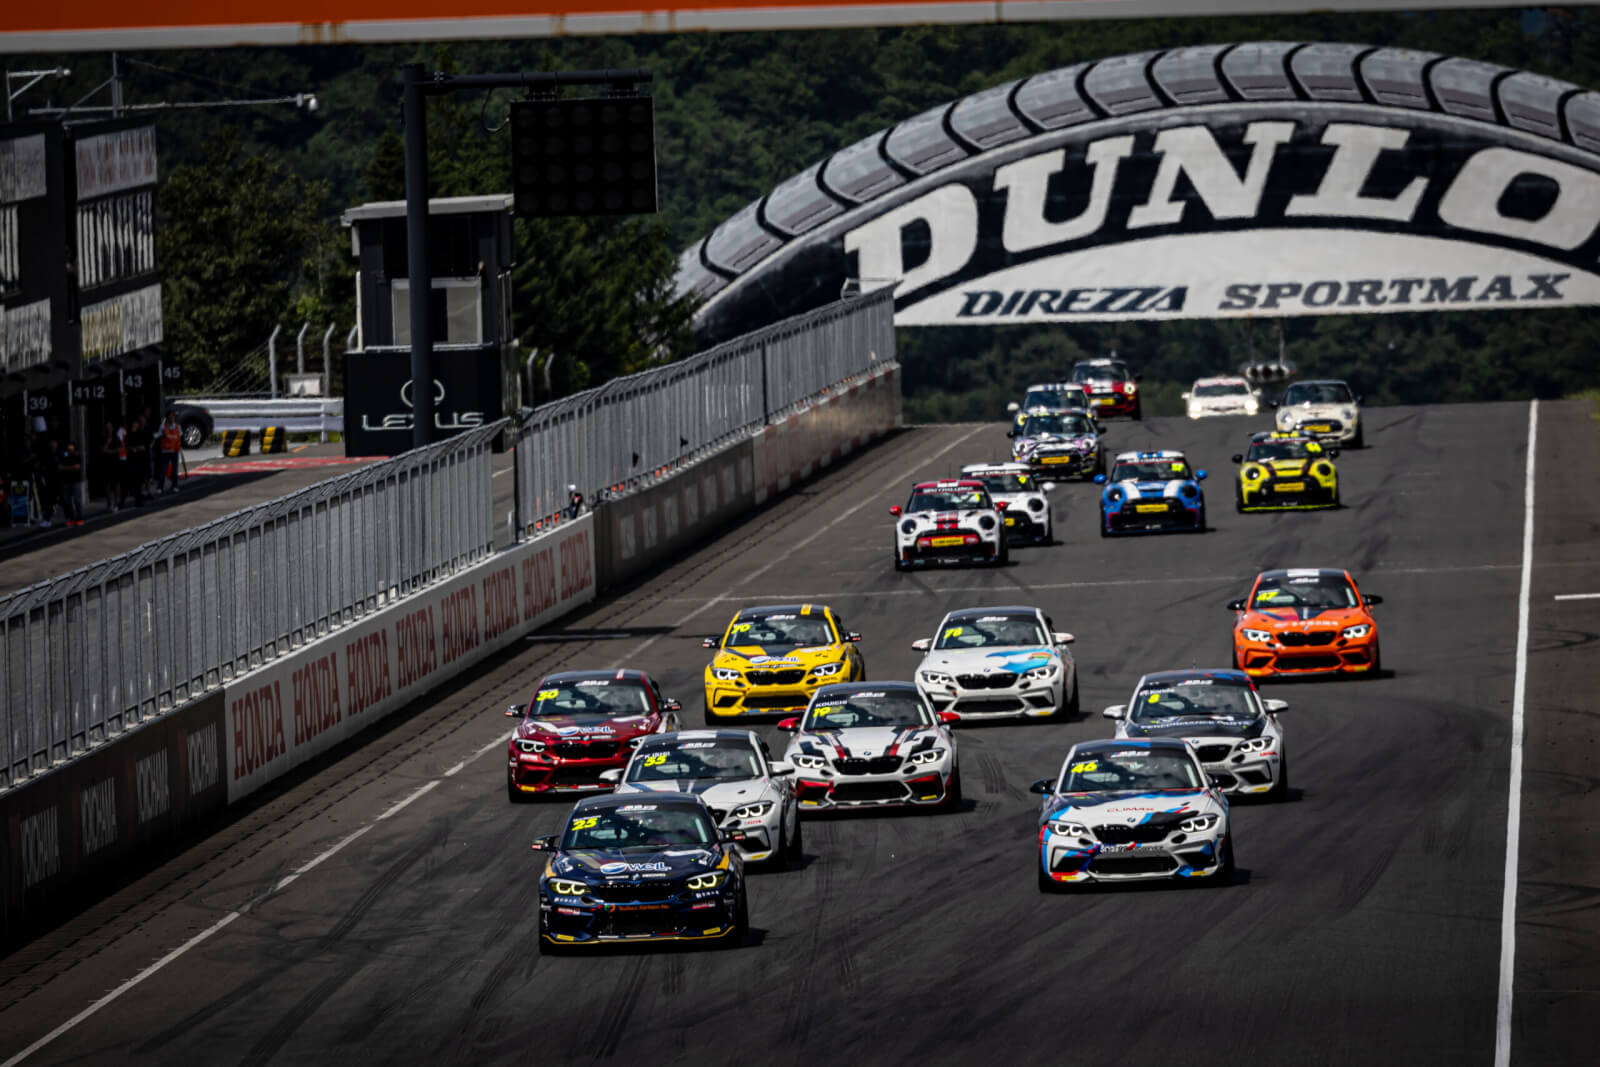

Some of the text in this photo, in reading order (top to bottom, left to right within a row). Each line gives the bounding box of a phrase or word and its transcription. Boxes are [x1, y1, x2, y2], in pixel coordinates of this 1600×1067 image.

[956, 272, 1570, 317] DIREZZA SPORTMAX
[73, 386, 89, 400] 41
[124, 375, 142, 389] 43
[164, 365, 181, 381] 45
[29, 395, 48, 410] 39
[523, 547, 557, 621] HONDA
[560, 529, 592, 601] HONDA
[441, 584, 480, 665] HONDA
[483, 565, 520, 640] HONDA
[346, 628, 391, 717] HONDA
[396, 608, 437, 690] HONDA
[292, 652, 341, 746] HONDA
[232, 680, 286, 780] HONDA
[644, 755, 668, 767] 55
[1070, 761, 1097, 773] 46
[571, 817, 598, 831] 25
